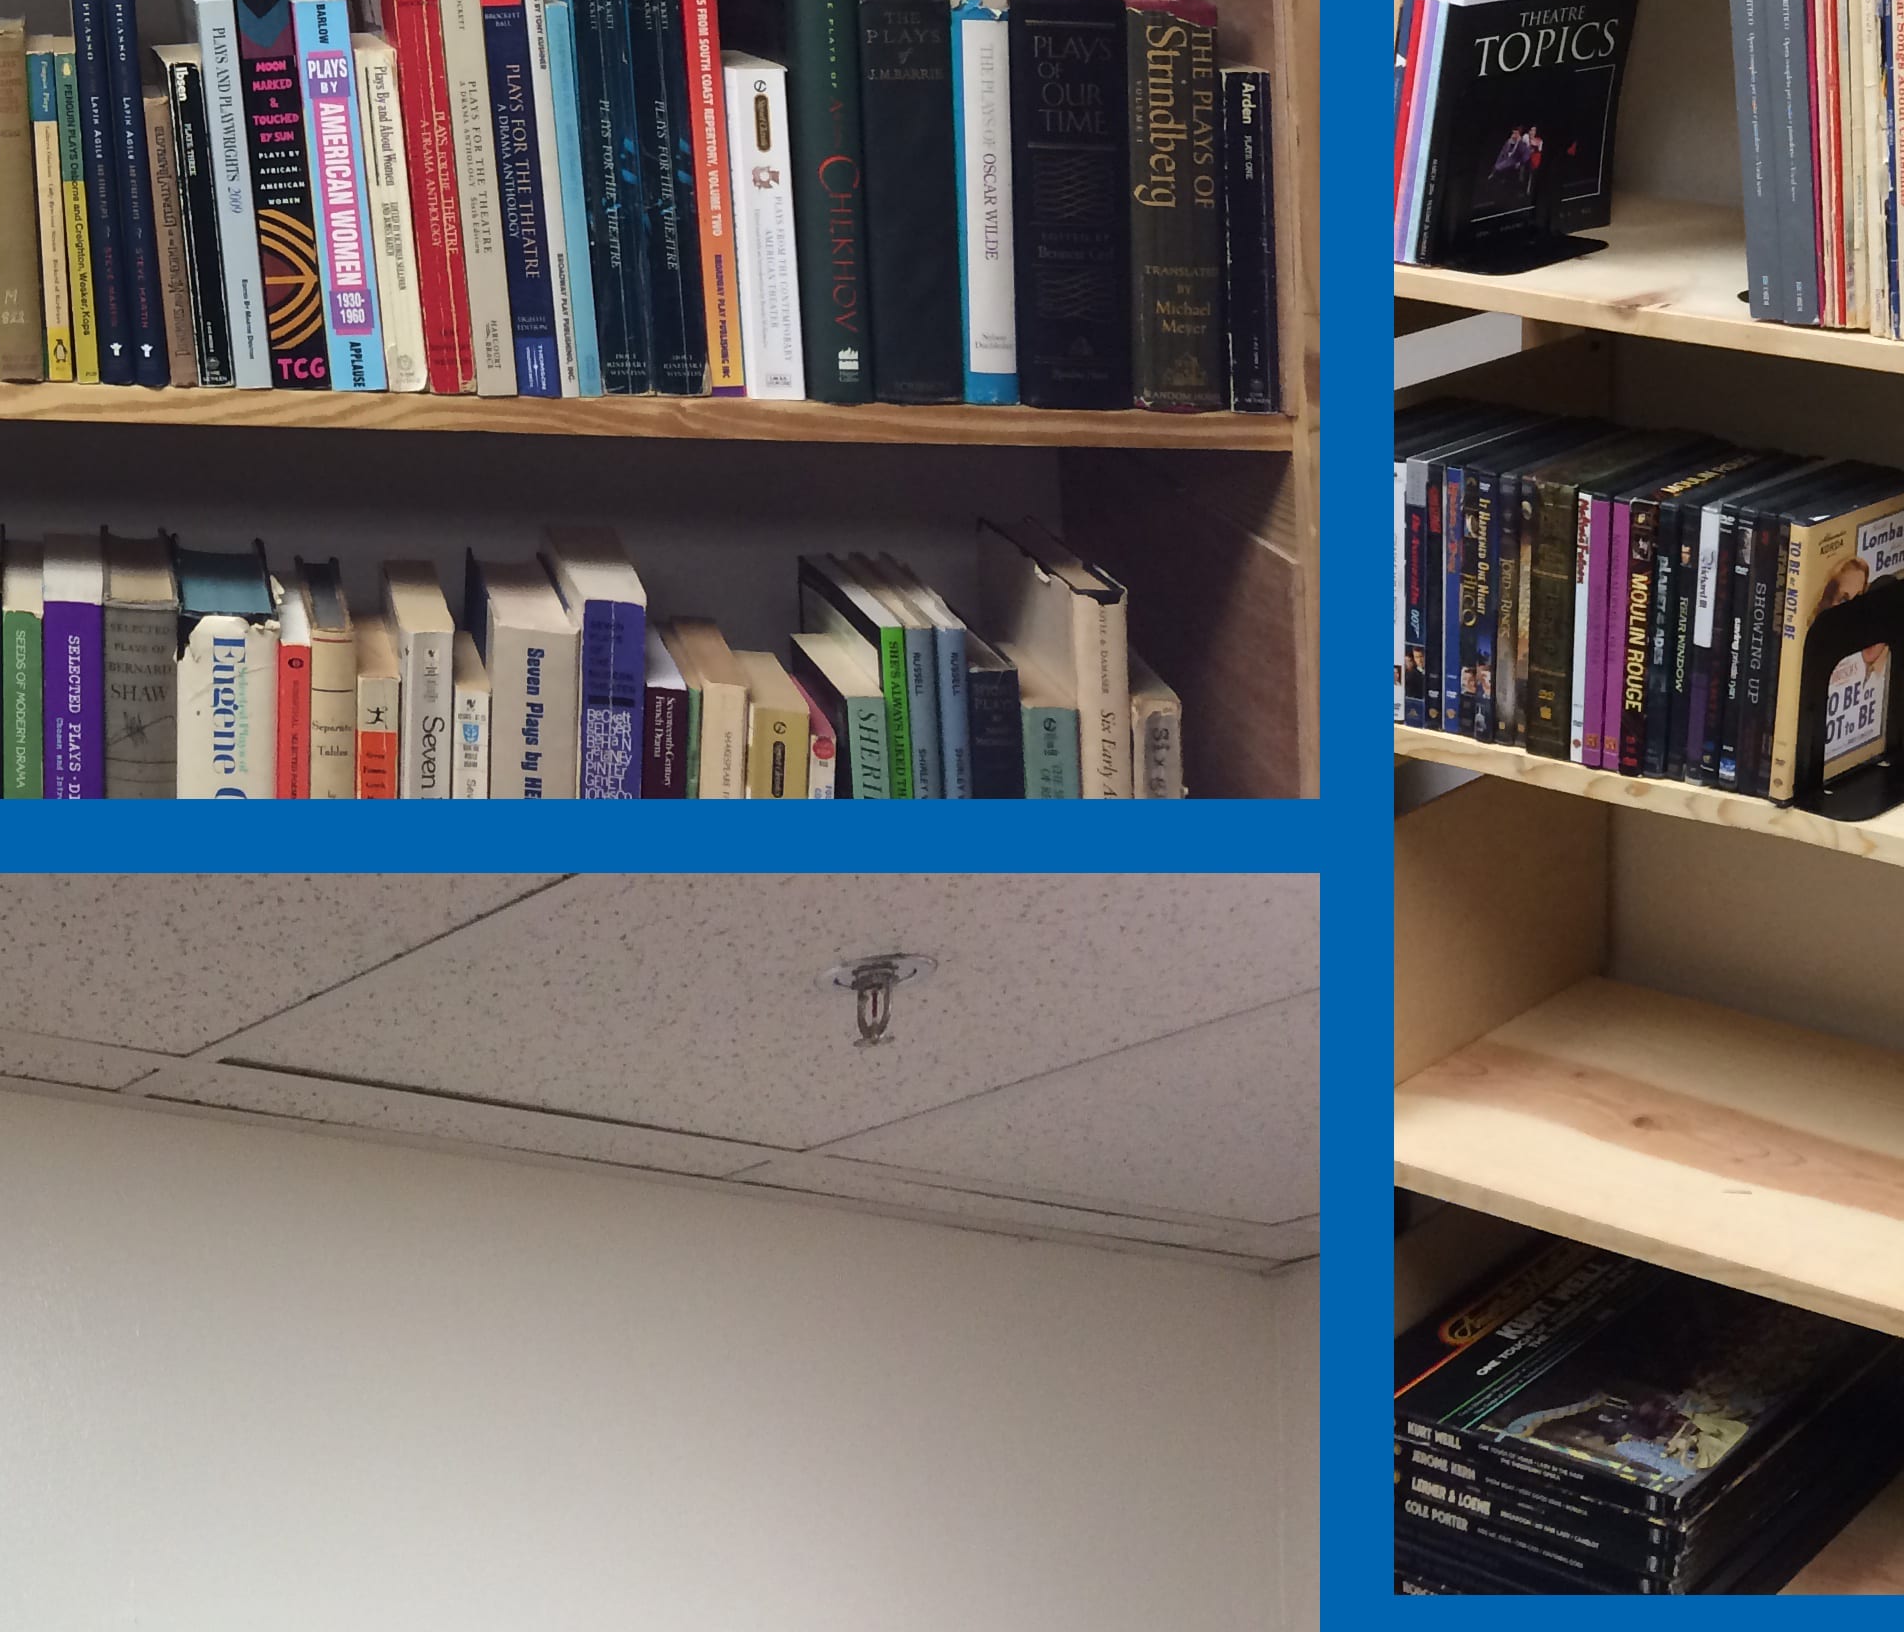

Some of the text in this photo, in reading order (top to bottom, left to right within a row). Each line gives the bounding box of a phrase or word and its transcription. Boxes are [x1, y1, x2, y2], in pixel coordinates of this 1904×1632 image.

[1518, 4, 1585, 28] THEATRE
[309, 60, 347, 78] PLAYS
[1475, 18, 1618, 77] TOPICS
[1133, 24, 1187, 208] Strindberg
[320, 103, 362, 286] AMERICAN WOMEN
[278, 358, 325, 379] TCG
[1626, 573, 1649, 713] MOULIN ROUGE
